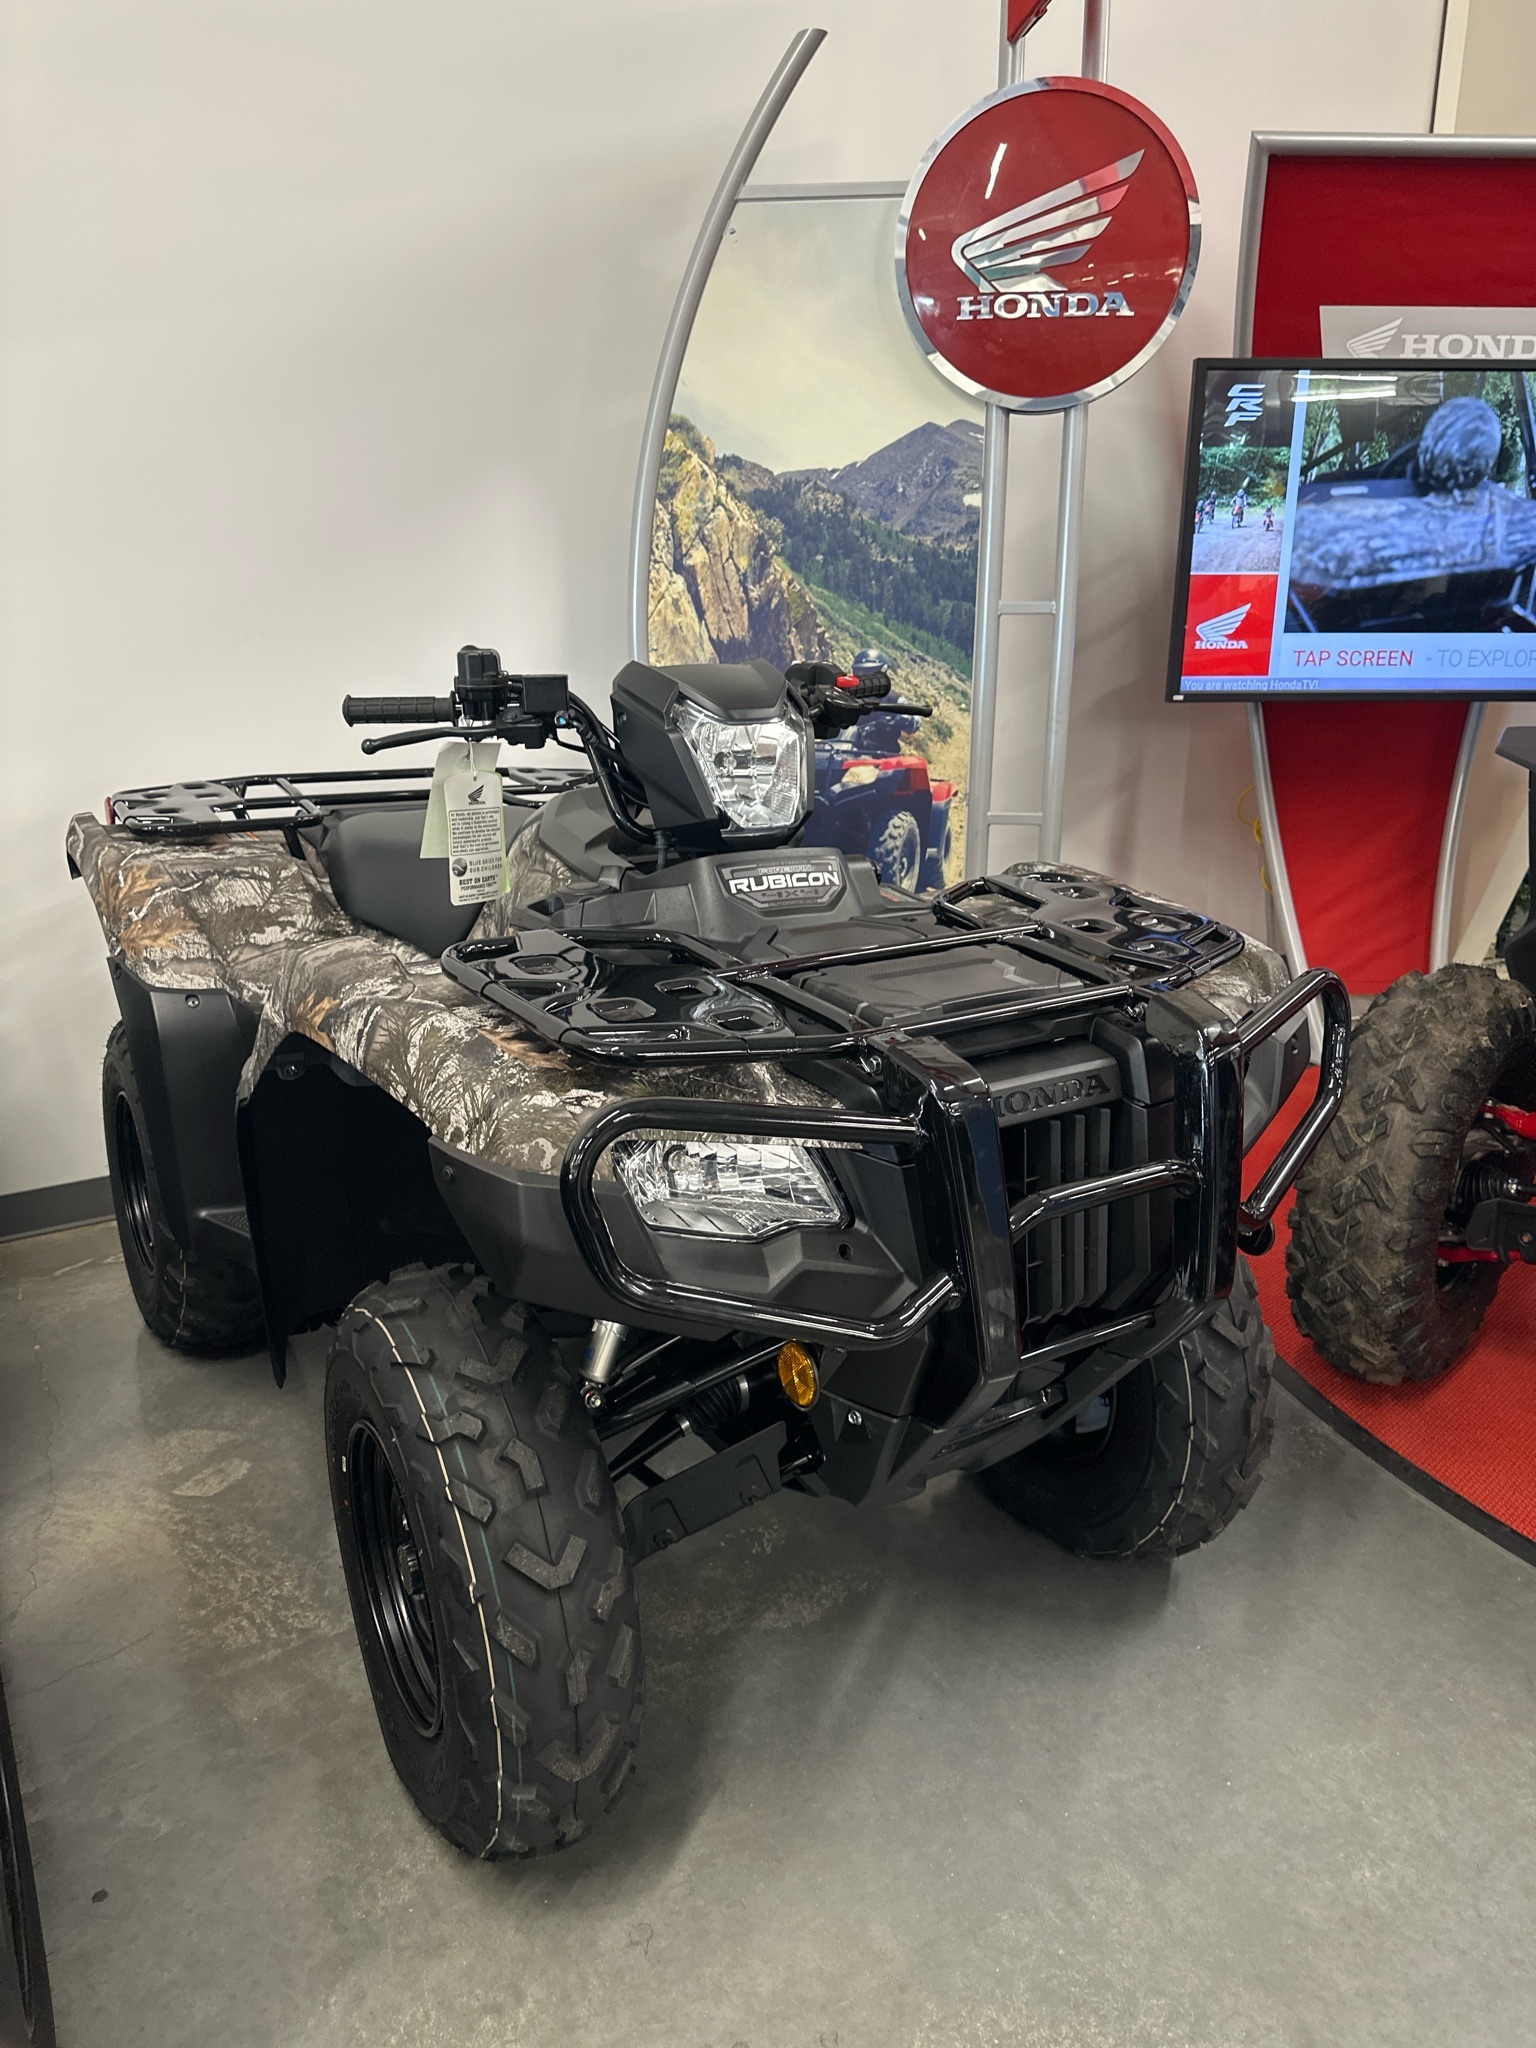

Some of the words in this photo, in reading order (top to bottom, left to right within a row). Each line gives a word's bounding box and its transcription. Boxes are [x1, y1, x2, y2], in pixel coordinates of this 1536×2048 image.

[956, 292, 1135, 321] HONDA
[1399, 333, 1536, 359] HOND
[1194, 640, 1249, 650] HONDA
[1293, 650, 1331, 667] TAP
[1336, 650, 1414, 667] SCREEN
[1437, 649, 1463, 667] TO
[1184, 680, 1204, 690] You
[1205, 682, 1221, 690] are
[1222, 680, 1268, 691] watching
[1269, 680, 1319, 690] HondaTV!
[469, 859, 481, 867] BLUE
[459, 878, 473, 886] BEST
[728, 871, 840, 894] RUBICON
